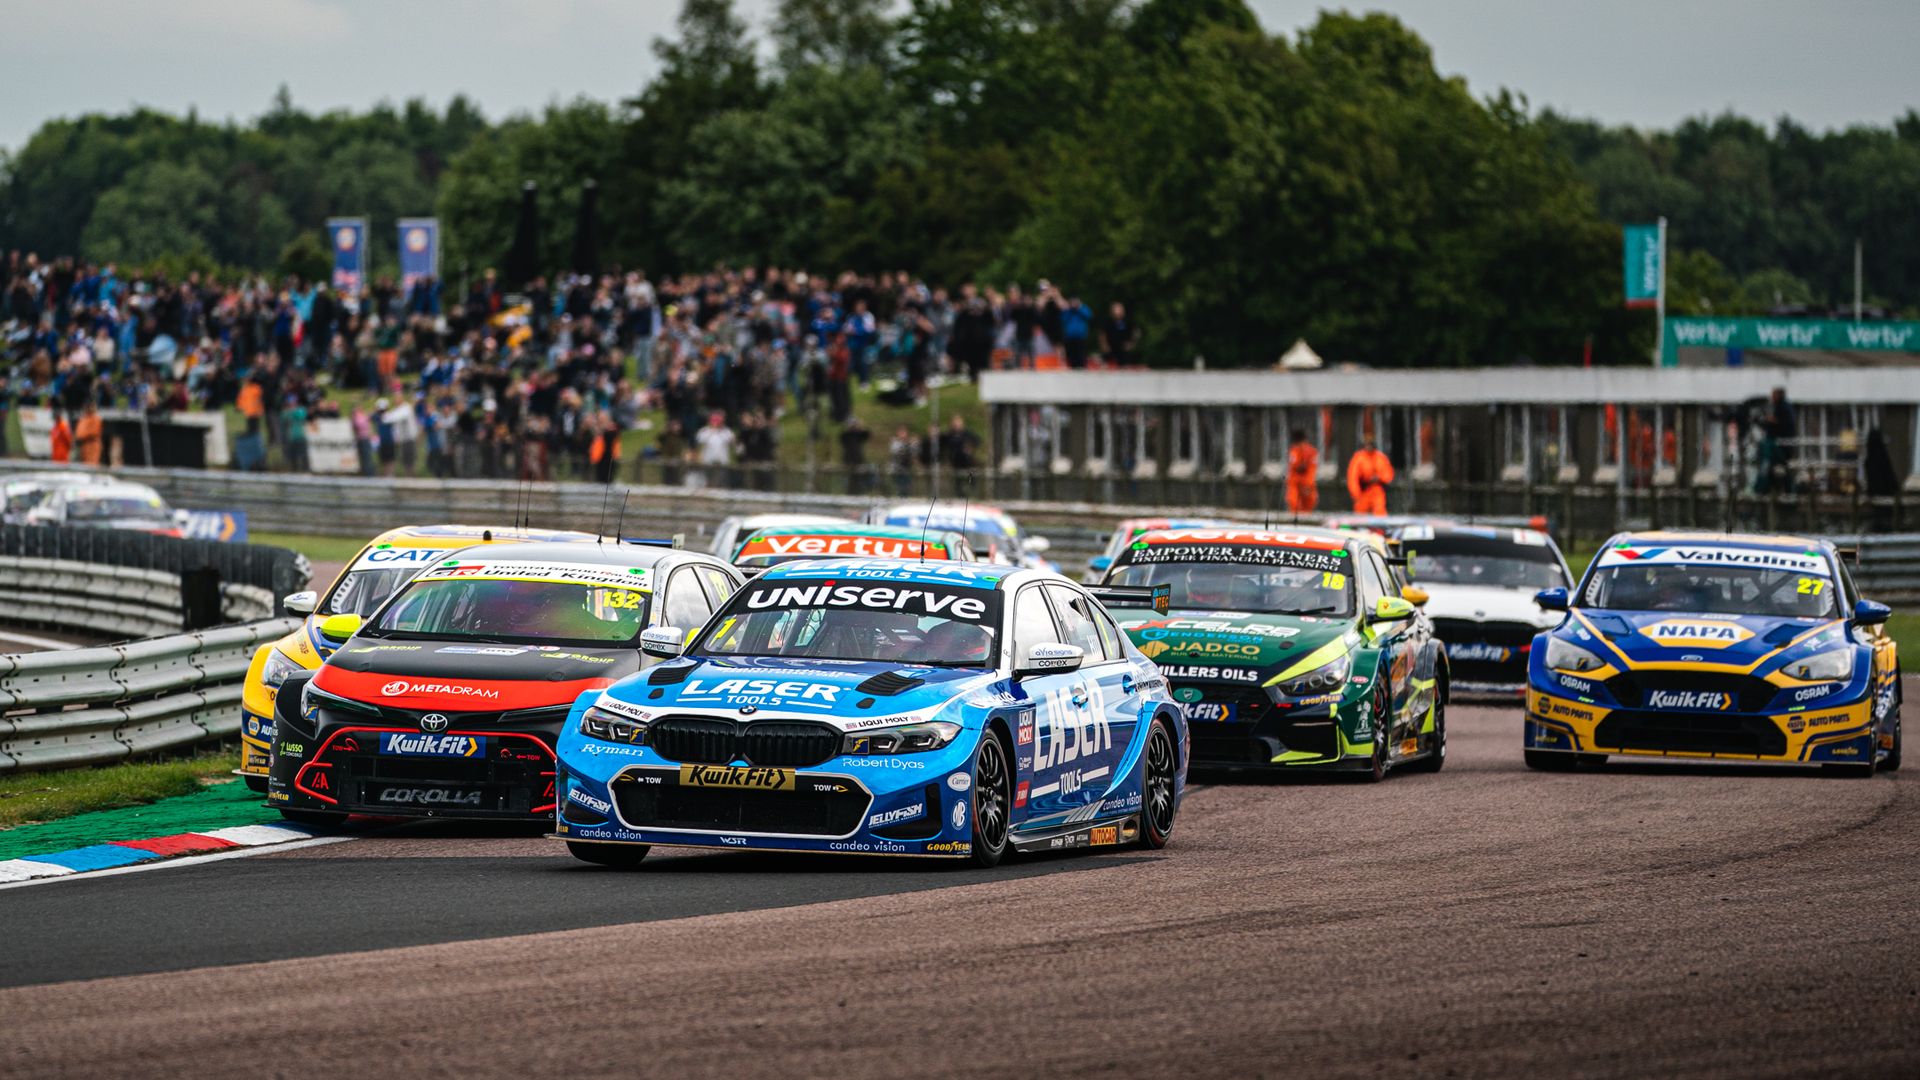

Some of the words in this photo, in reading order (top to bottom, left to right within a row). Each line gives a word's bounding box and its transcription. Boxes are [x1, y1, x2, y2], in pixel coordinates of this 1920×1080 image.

[367, 550, 443, 562] CAT
[1131, 555, 1170, 563] FIXED
[1174, 554, 1198, 562] FEE
[1200, 554, 1269, 564] FINANCIAL
[1272, 559, 1339, 571] PLANNING
[1134, 547, 1233, 557] EMPOWER
[1241, 548, 1342, 567] PARTNERS
[1676, 550, 1817, 569] Valvoline
[561, 573, 648, 588] Kingdom
[846, 569, 911, 579] TOOLS
[1322, 572, 1345, 590] 18
[1796, 578, 1824, 595] 27
[603, 592, 641, 609] 132
[709, 614, 737, 647] 1
[1658, 625, 1736, 639] NAPA
[1172, 641, 1261, 655] JADCO
[1222, 668, 1258, 681] OILS
[409, 683, 499, 699] METADRAM
[680, 680, 841, 702] LASER
[1560, 675, 1591, 693] OSRAM
[726, 695, 782, 706] TOOLS
[1300, 693, 1342, 705] GOODYEAR
[1795, 685, 1830, 702] OSRAM
[609, 702, 627, 712] LIQUI
[627, 707, 643, 717] MOLY
[1552, 704, 1570, 717] AUTO
[1570, 708, 1593, 721] PARTS
[858, 719, 883, 728] LIQUI
[885, 716, 909, 724] MOLY
[1020, 711, 1033, 726] LIQUI
[1808, 715, 1828, 727] AUTO
[1829, 713, 1850, 725] PARTS
[1019, 727, 1032, 743] MOLY
[286, 742, 303, 753] LUSSO
[581, 743, 644, 757] Ryman
[843, 757, 888, 768] Robert
[892, 758, 925, 770] Dyas
[813, 784, 832, 792] TOW
[1060, 769, 1081, 795] TOOLS
[379, 788, 482, 805] COROLLA
[569, 788, 612, 812] JELLYFISH
[1103, 795, 1126, 811] candeo
[1126, 791, 1142, 805] vision
[869, 803, 923, 826] JELLYFISH
[580, 828, 611, 838] candeo
[614, 828, 642, 840] vision
[1090, 828, 1117, 844] AUTOCAR
[829, 840, 870, 851] candeo
[874, 840, 905, 852] vision
[927, 841, 970, 852] GOODYEAR
